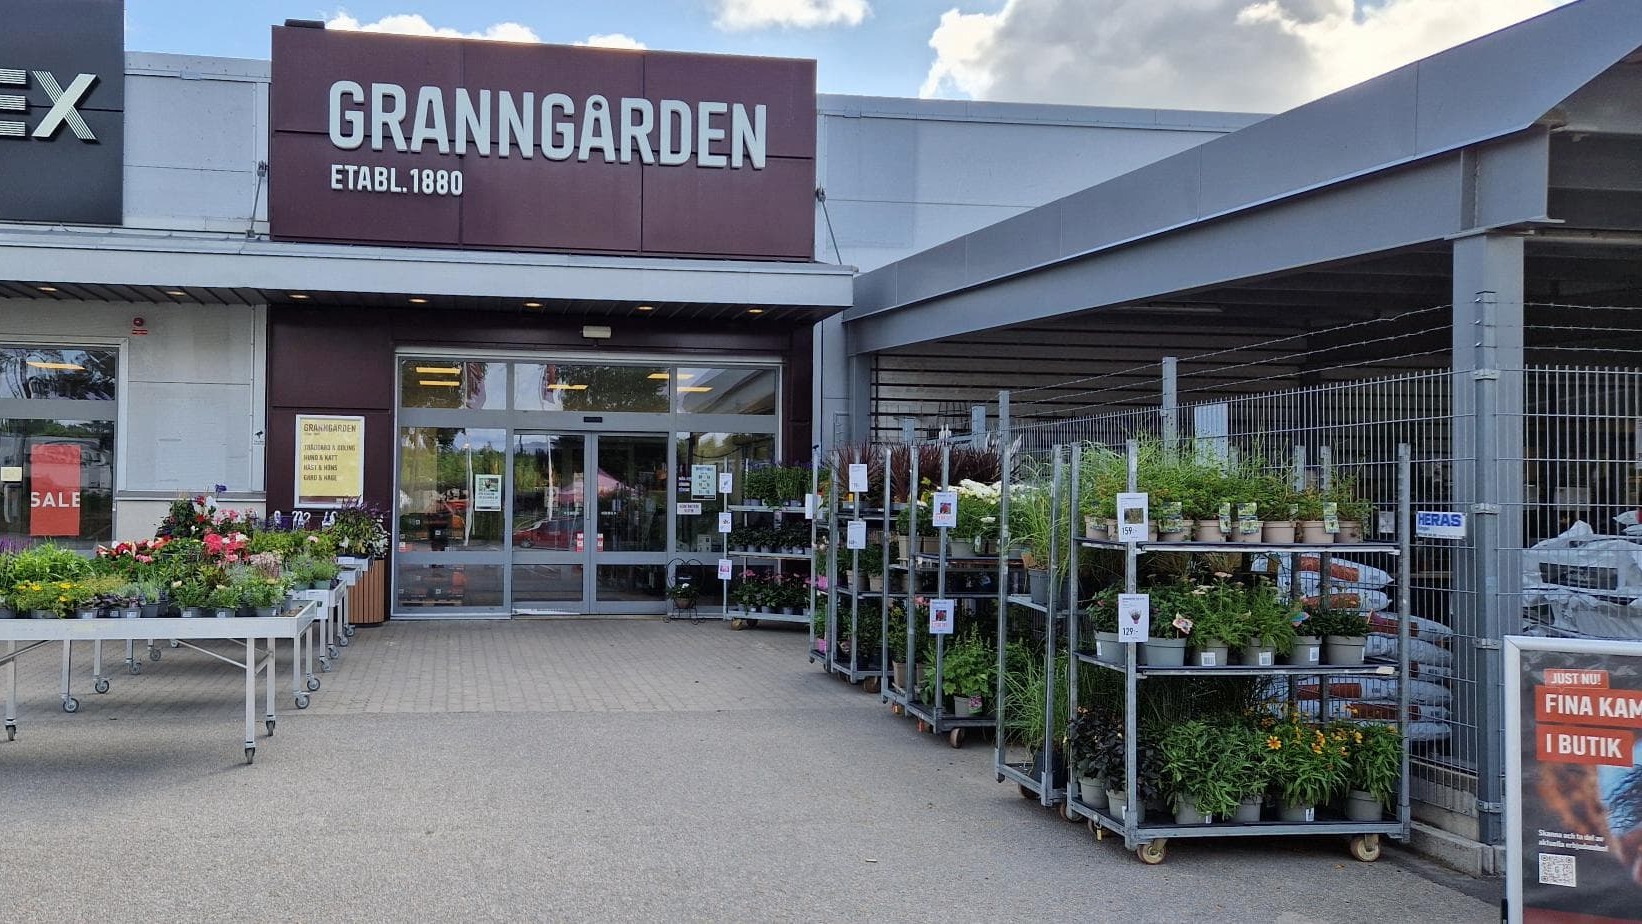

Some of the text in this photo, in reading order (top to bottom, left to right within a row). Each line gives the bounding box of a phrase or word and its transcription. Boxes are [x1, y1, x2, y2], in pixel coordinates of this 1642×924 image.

[329, 80, 767, 169] GRANNGÅRDEN
[31, 491, 81, 508] SALE
[1418, 513, 1462, 527] HERAS
[1551, 672, 1602, 685] JUST NU!
[1545, 693, 1594, 716] FINA
[1546, 733, 1623, 759] I BUTIK
